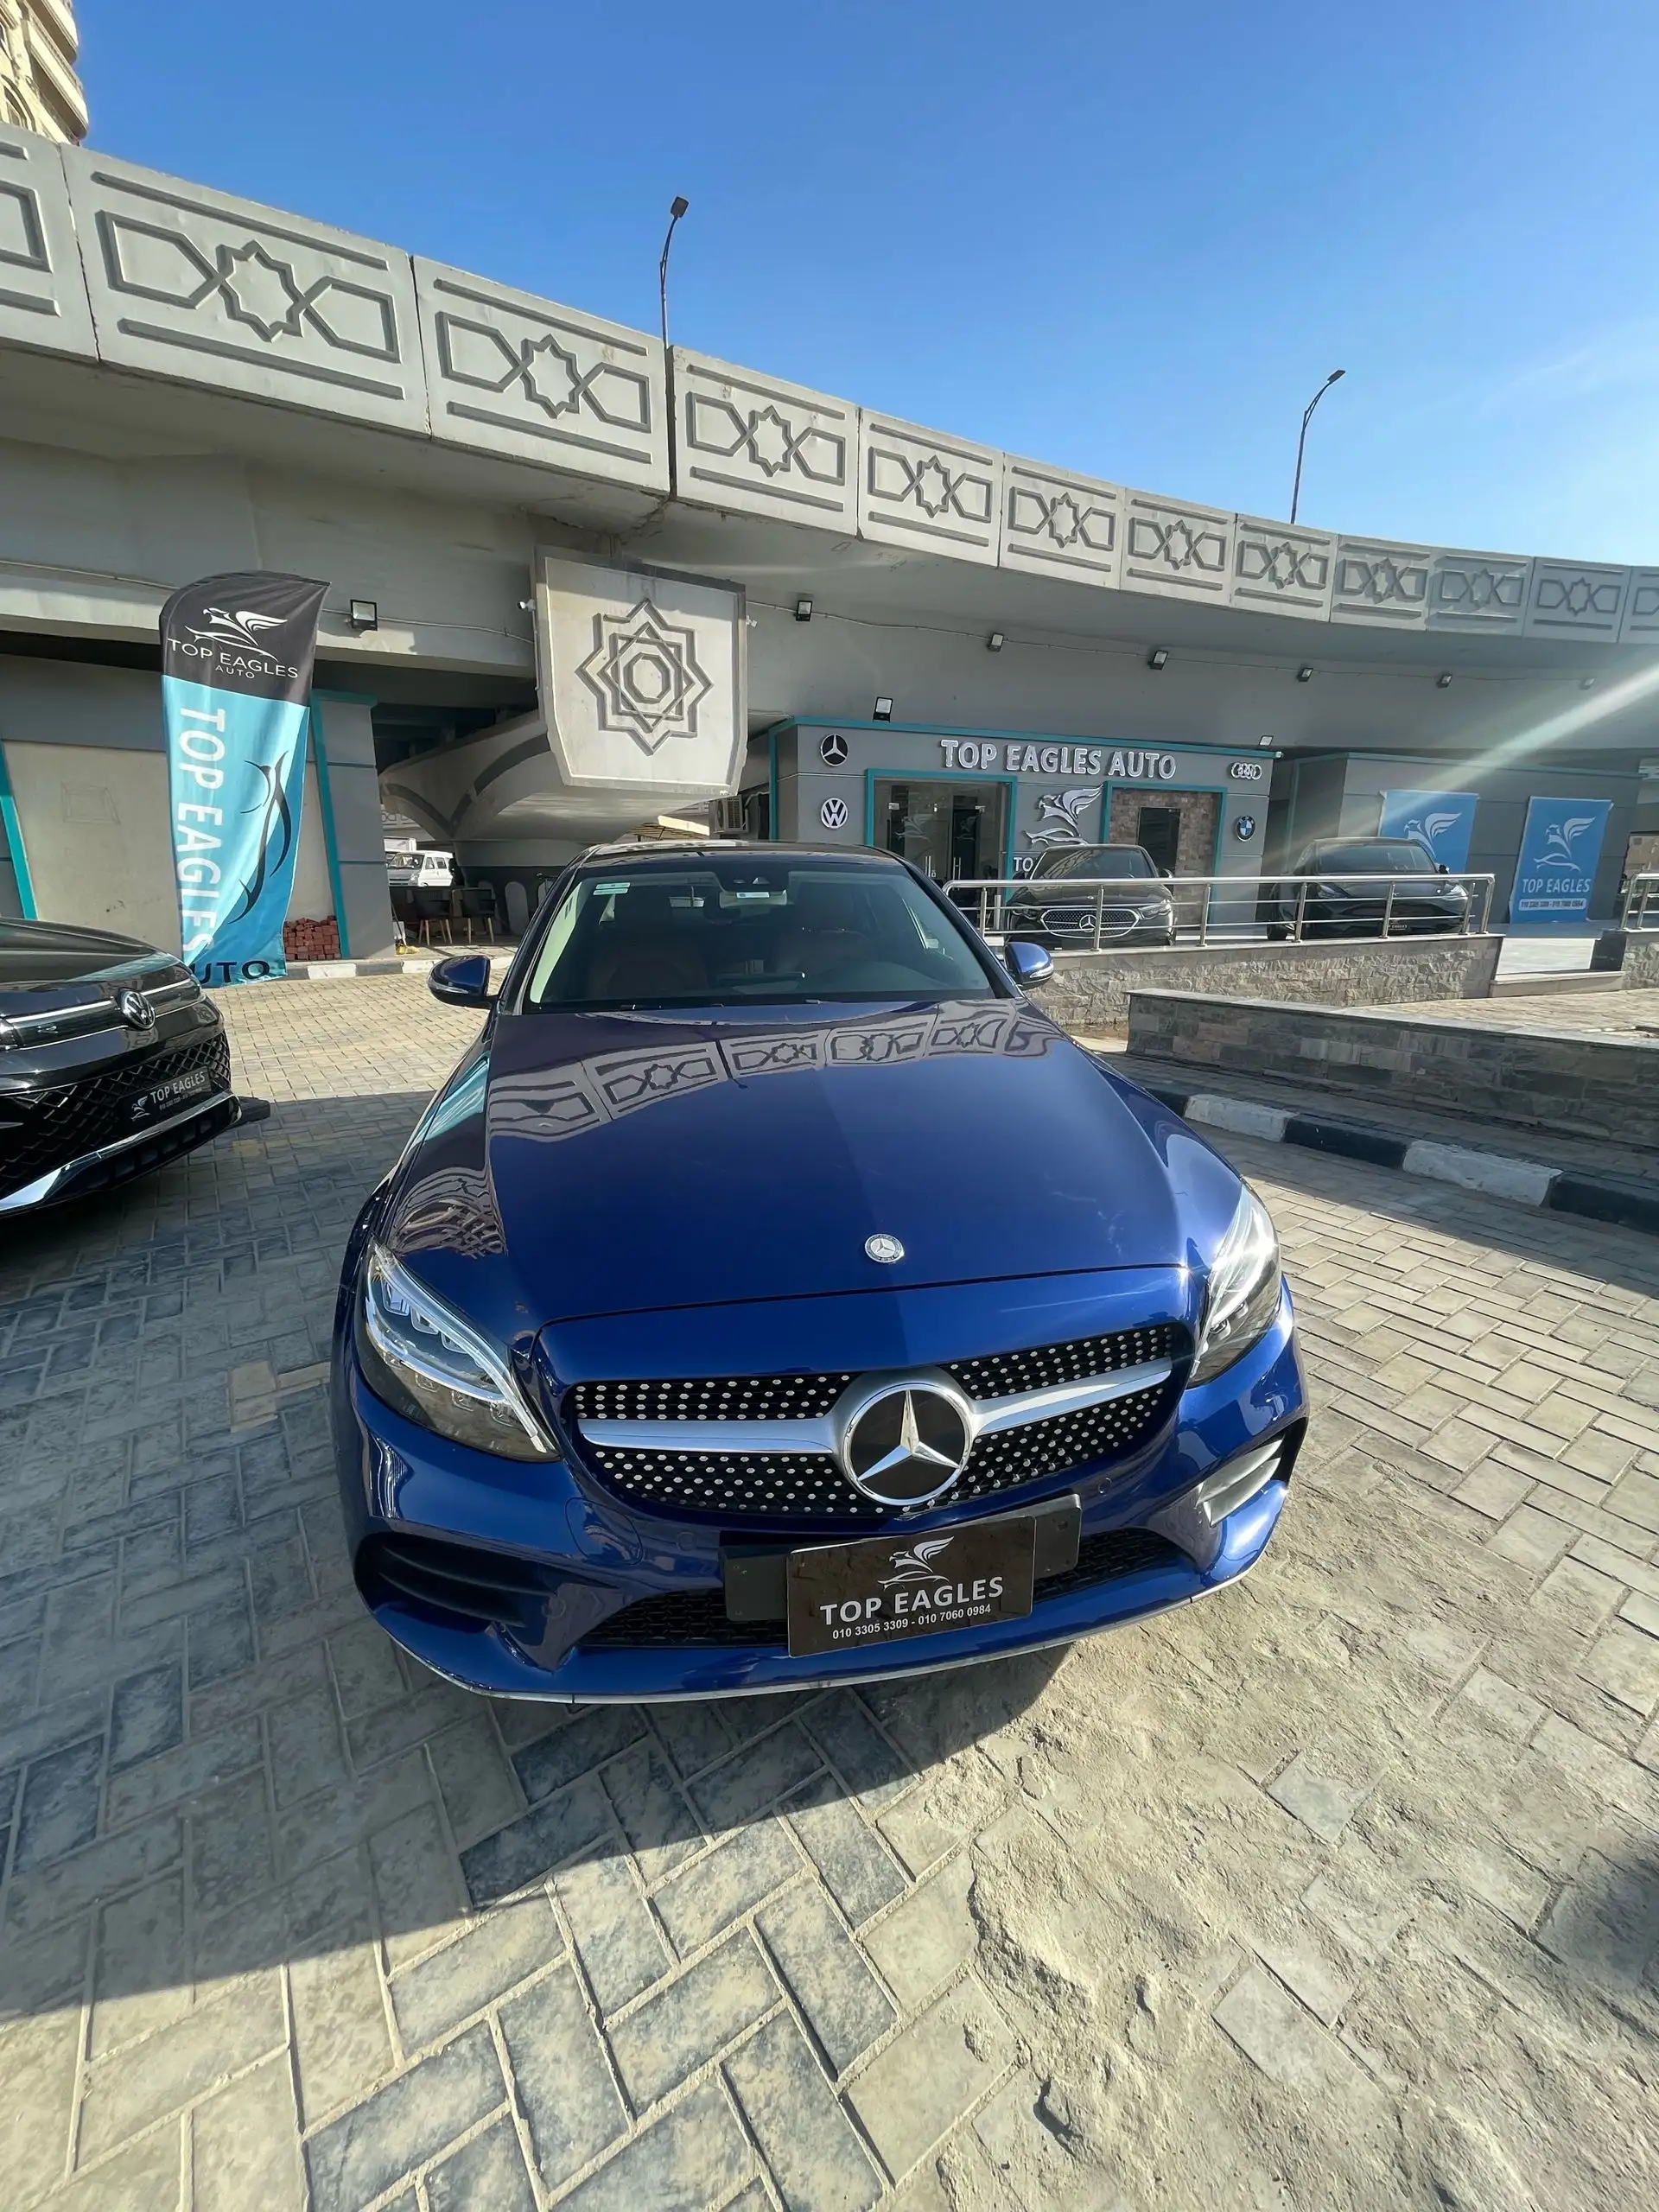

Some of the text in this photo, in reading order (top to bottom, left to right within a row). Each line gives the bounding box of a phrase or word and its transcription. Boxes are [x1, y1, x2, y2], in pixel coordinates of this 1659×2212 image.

[167, 638, 299, 678] TOP EAGLES
[215, 664, 256, 679] AUTO
[177, 708, 226, 790] TOP
[940, 739, 1176, 779] TOP EAGLES AUTO
[1013, 856, 1039, 872] TO
[1522, 878, 1592, 893] TOP EAGLES
[188, 960, 270, 984] UTO
[149, 1085, 170, 1104] TOP
[172, 1071, 206, 1095] EAGLES
[819, 1576, 1003, 1625] TOP EAGLES
[832, 1628, 852, 1640] 010
[855, 1622, 881, 1636] 3305
[883, 1618, 909, 1631] 3309
[918, 1613, 937, 1625] 010
[939, 1608, 964, 1622] 7060
[967, 1604, 991, 1617] 0984
